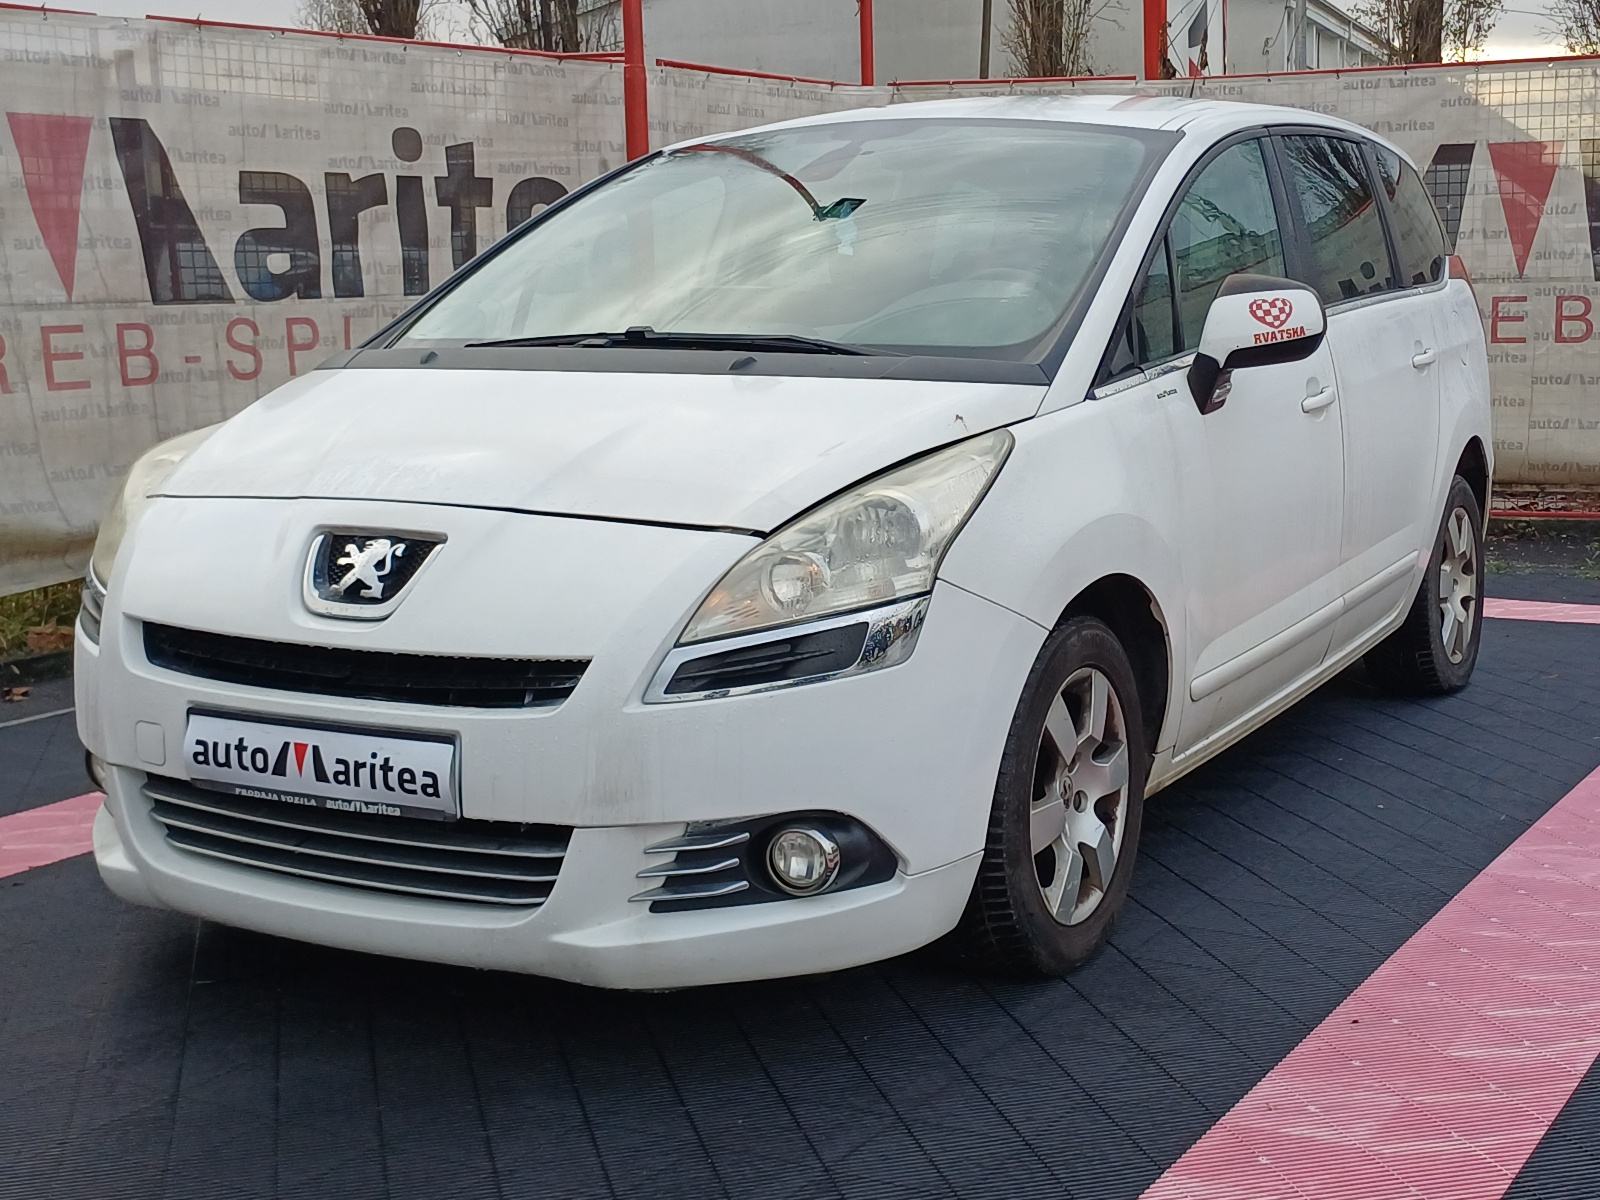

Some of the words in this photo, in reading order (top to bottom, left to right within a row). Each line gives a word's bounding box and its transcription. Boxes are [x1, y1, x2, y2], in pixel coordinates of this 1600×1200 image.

[1343, 76, 1437, 91] autoMaritea
[324, 102, 409, 119] autoMaritea
[228, 122, 321, 141] autoMaritea
[192, 736, 441, 799] autoMaritea
